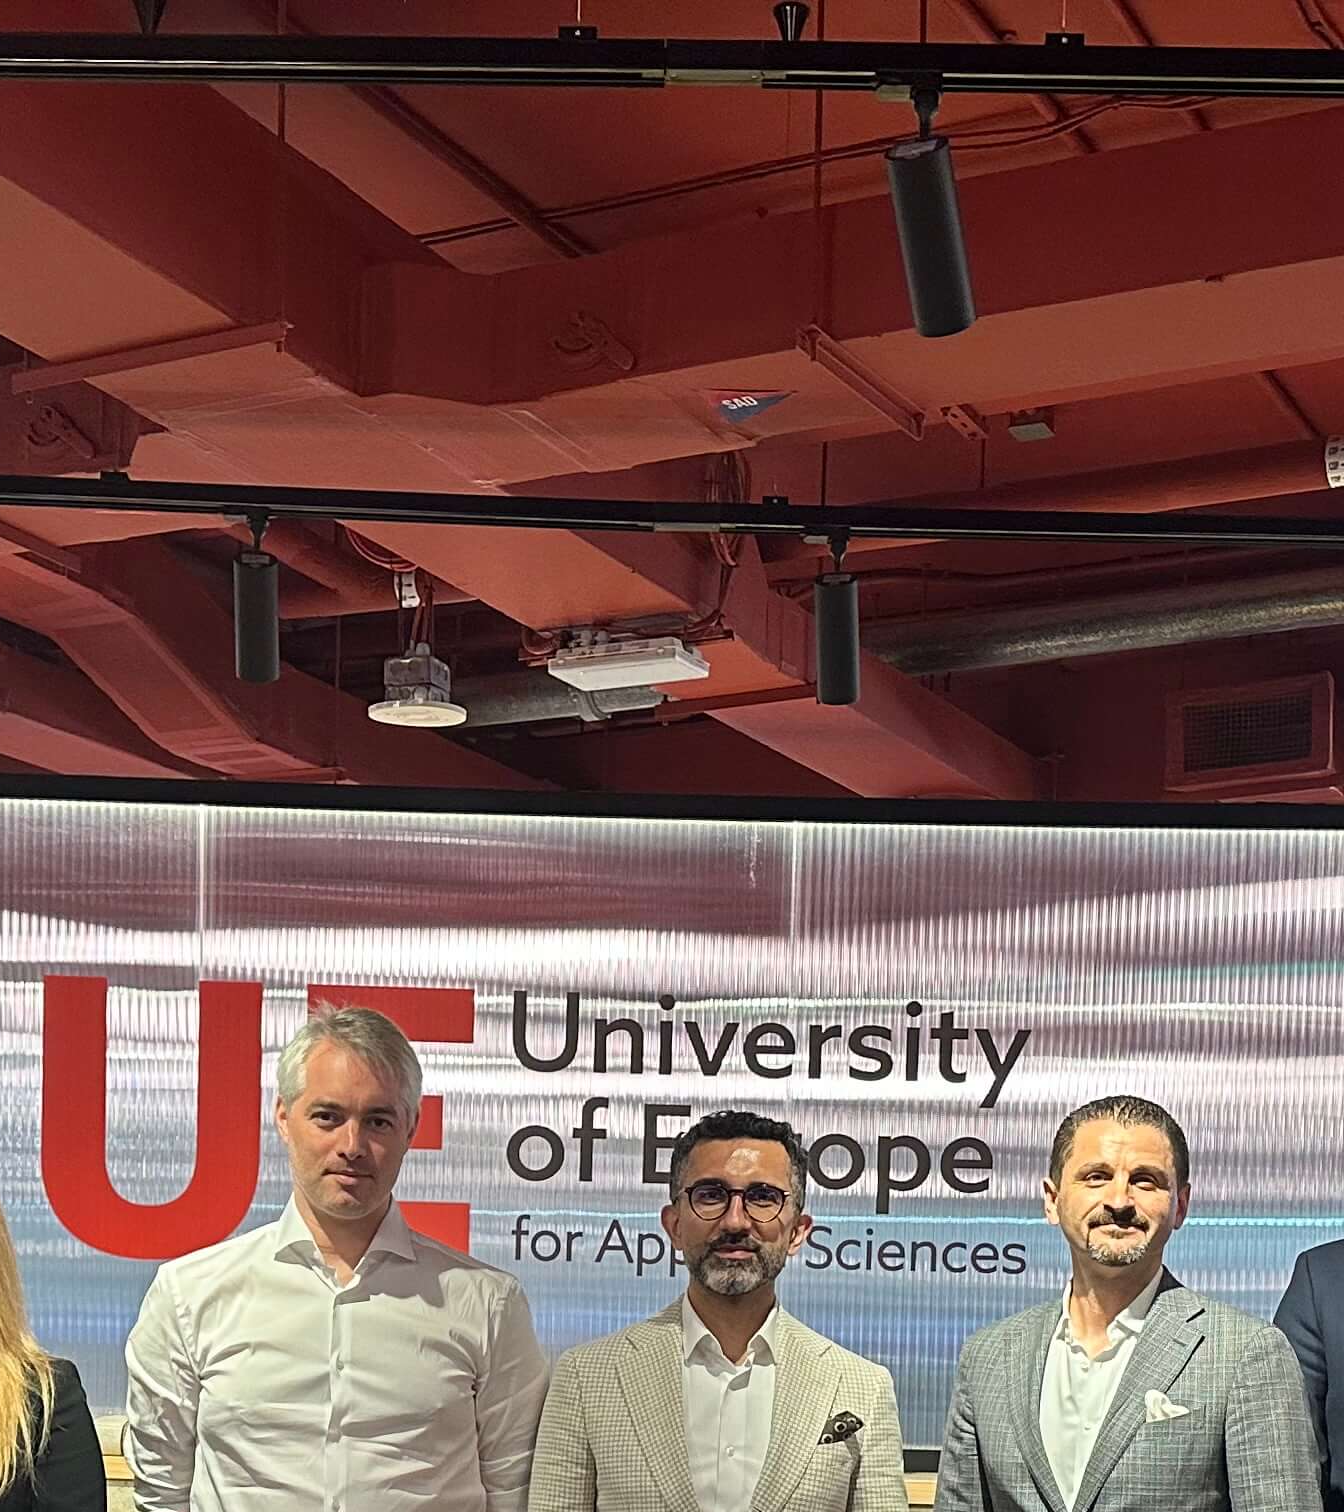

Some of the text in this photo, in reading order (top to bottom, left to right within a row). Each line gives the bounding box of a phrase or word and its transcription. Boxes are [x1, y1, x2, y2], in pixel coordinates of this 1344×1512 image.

[512, 990, 1032, 1108] University
[506, 1097, 994, 1215] of Eope
[512, 1214, 583, 1262] for
[806, 1226, 1026, 1274] Sciences
